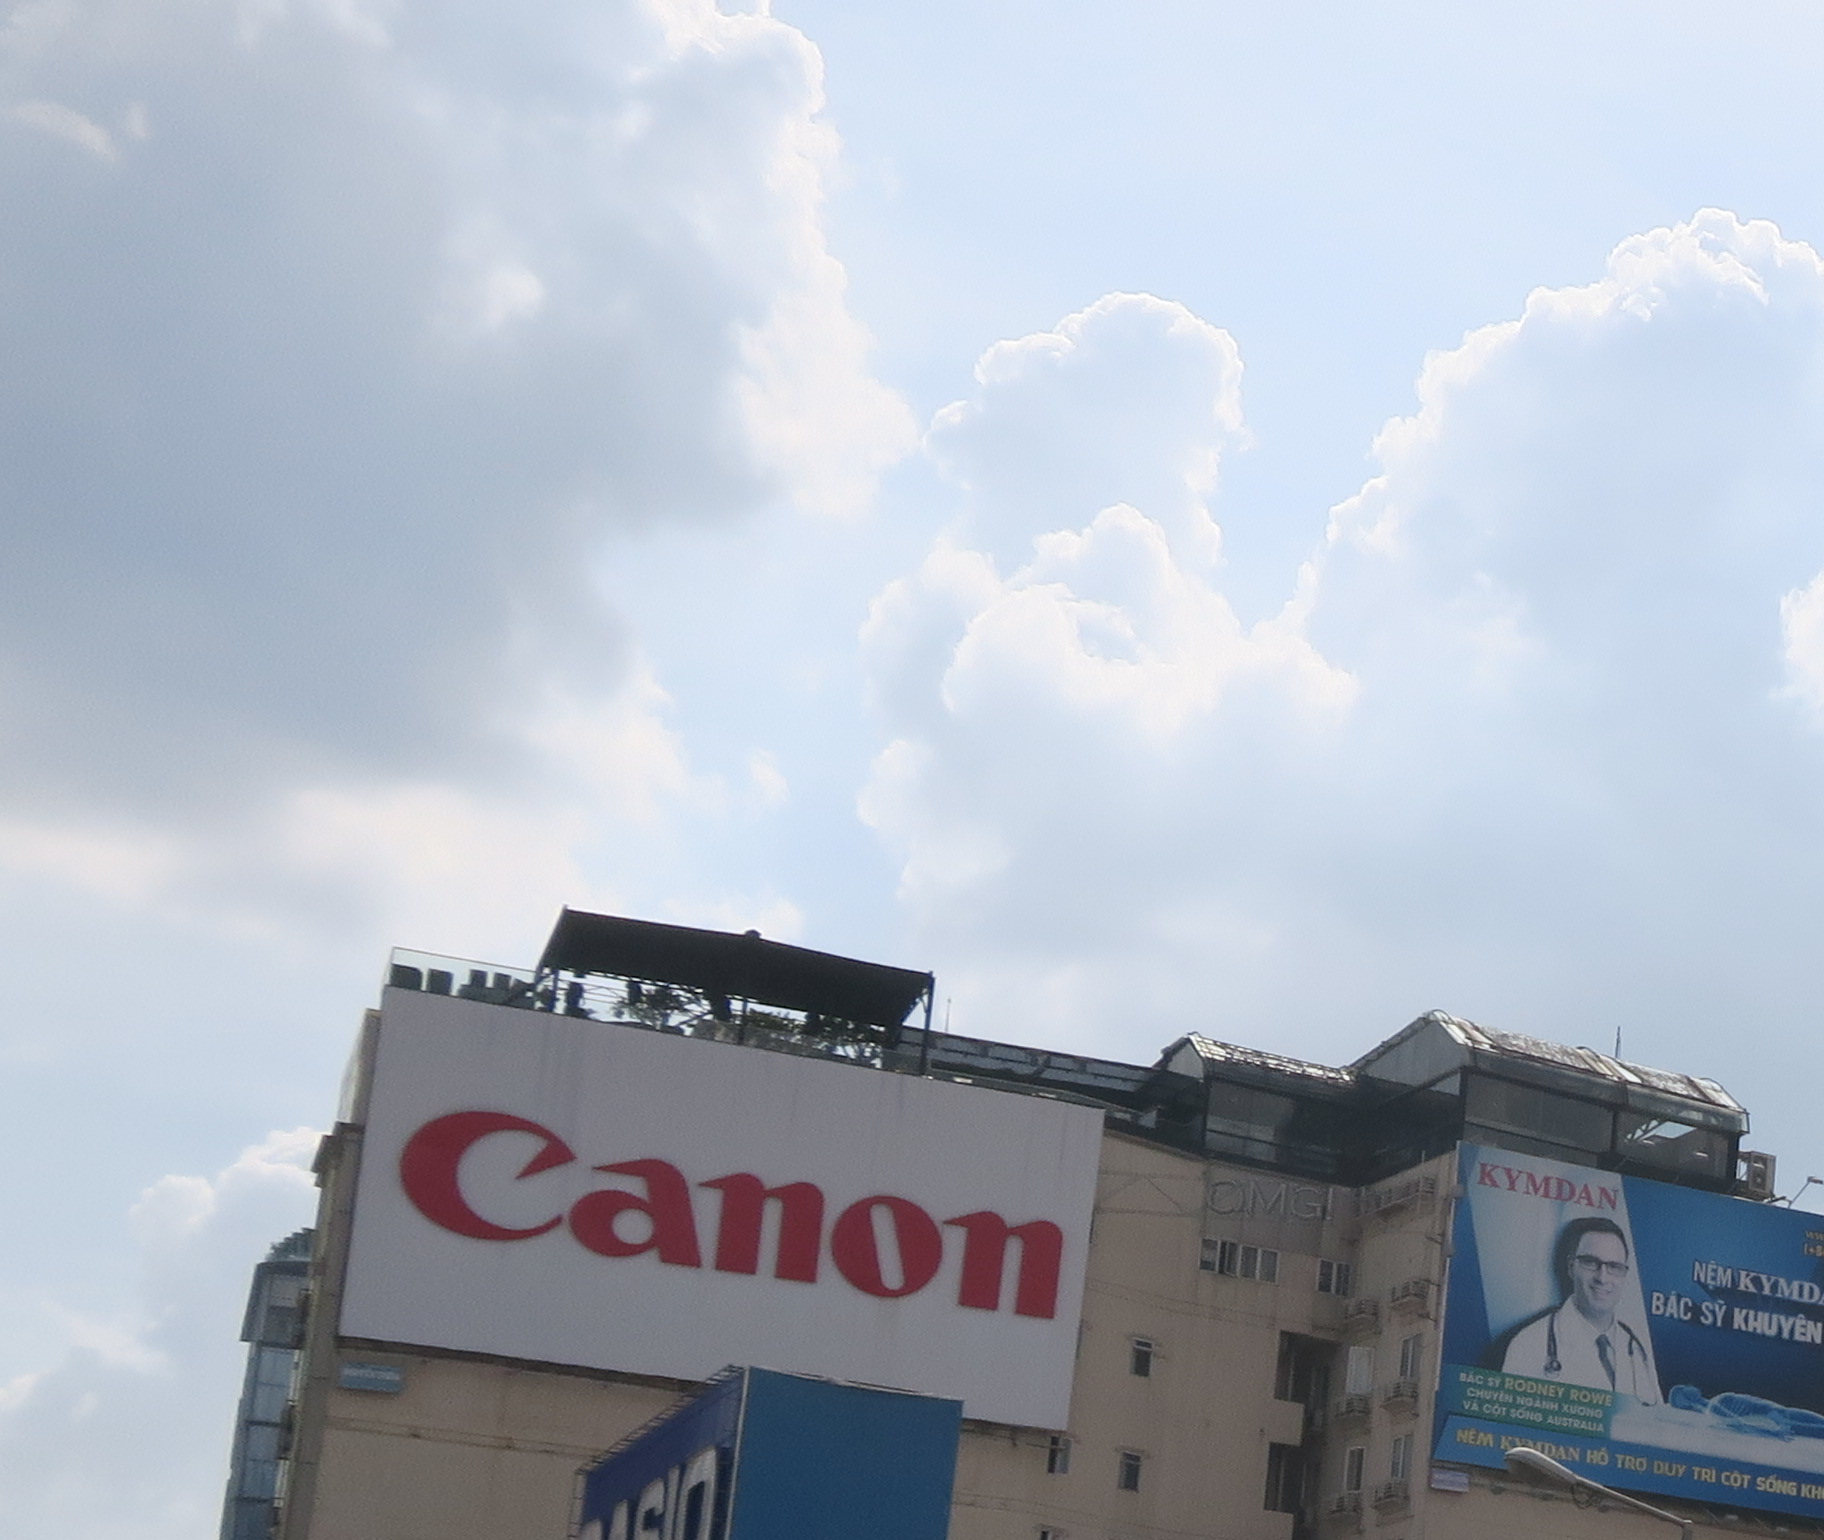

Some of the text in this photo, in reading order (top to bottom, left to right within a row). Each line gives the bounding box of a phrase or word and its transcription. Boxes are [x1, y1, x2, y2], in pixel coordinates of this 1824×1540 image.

[1477, 1162, 1619, 1211] KYMDAN
[399, 1110, 1064, 1319] Canon
[1693, 1259, 1732, 1290] NỆM
[1651, 1290, 1692, 1321] BÁC
[1700, 1299, 1727, 1328] SỸ
[1733, 1307, 1823, 1345] KHUYÊN
[1504, 1377, 1565, 1399] RODNEY
[1570, 1388, 1613, 1407] ROWE
[1546, 1415, 1605, 1433] AUSTRALIA
[1653, 1459, 1687, 1478] DUY
[1720, 1470, 1752, 1490] CỘT
[1756, 1474, 1798, 1496] SỐNG
